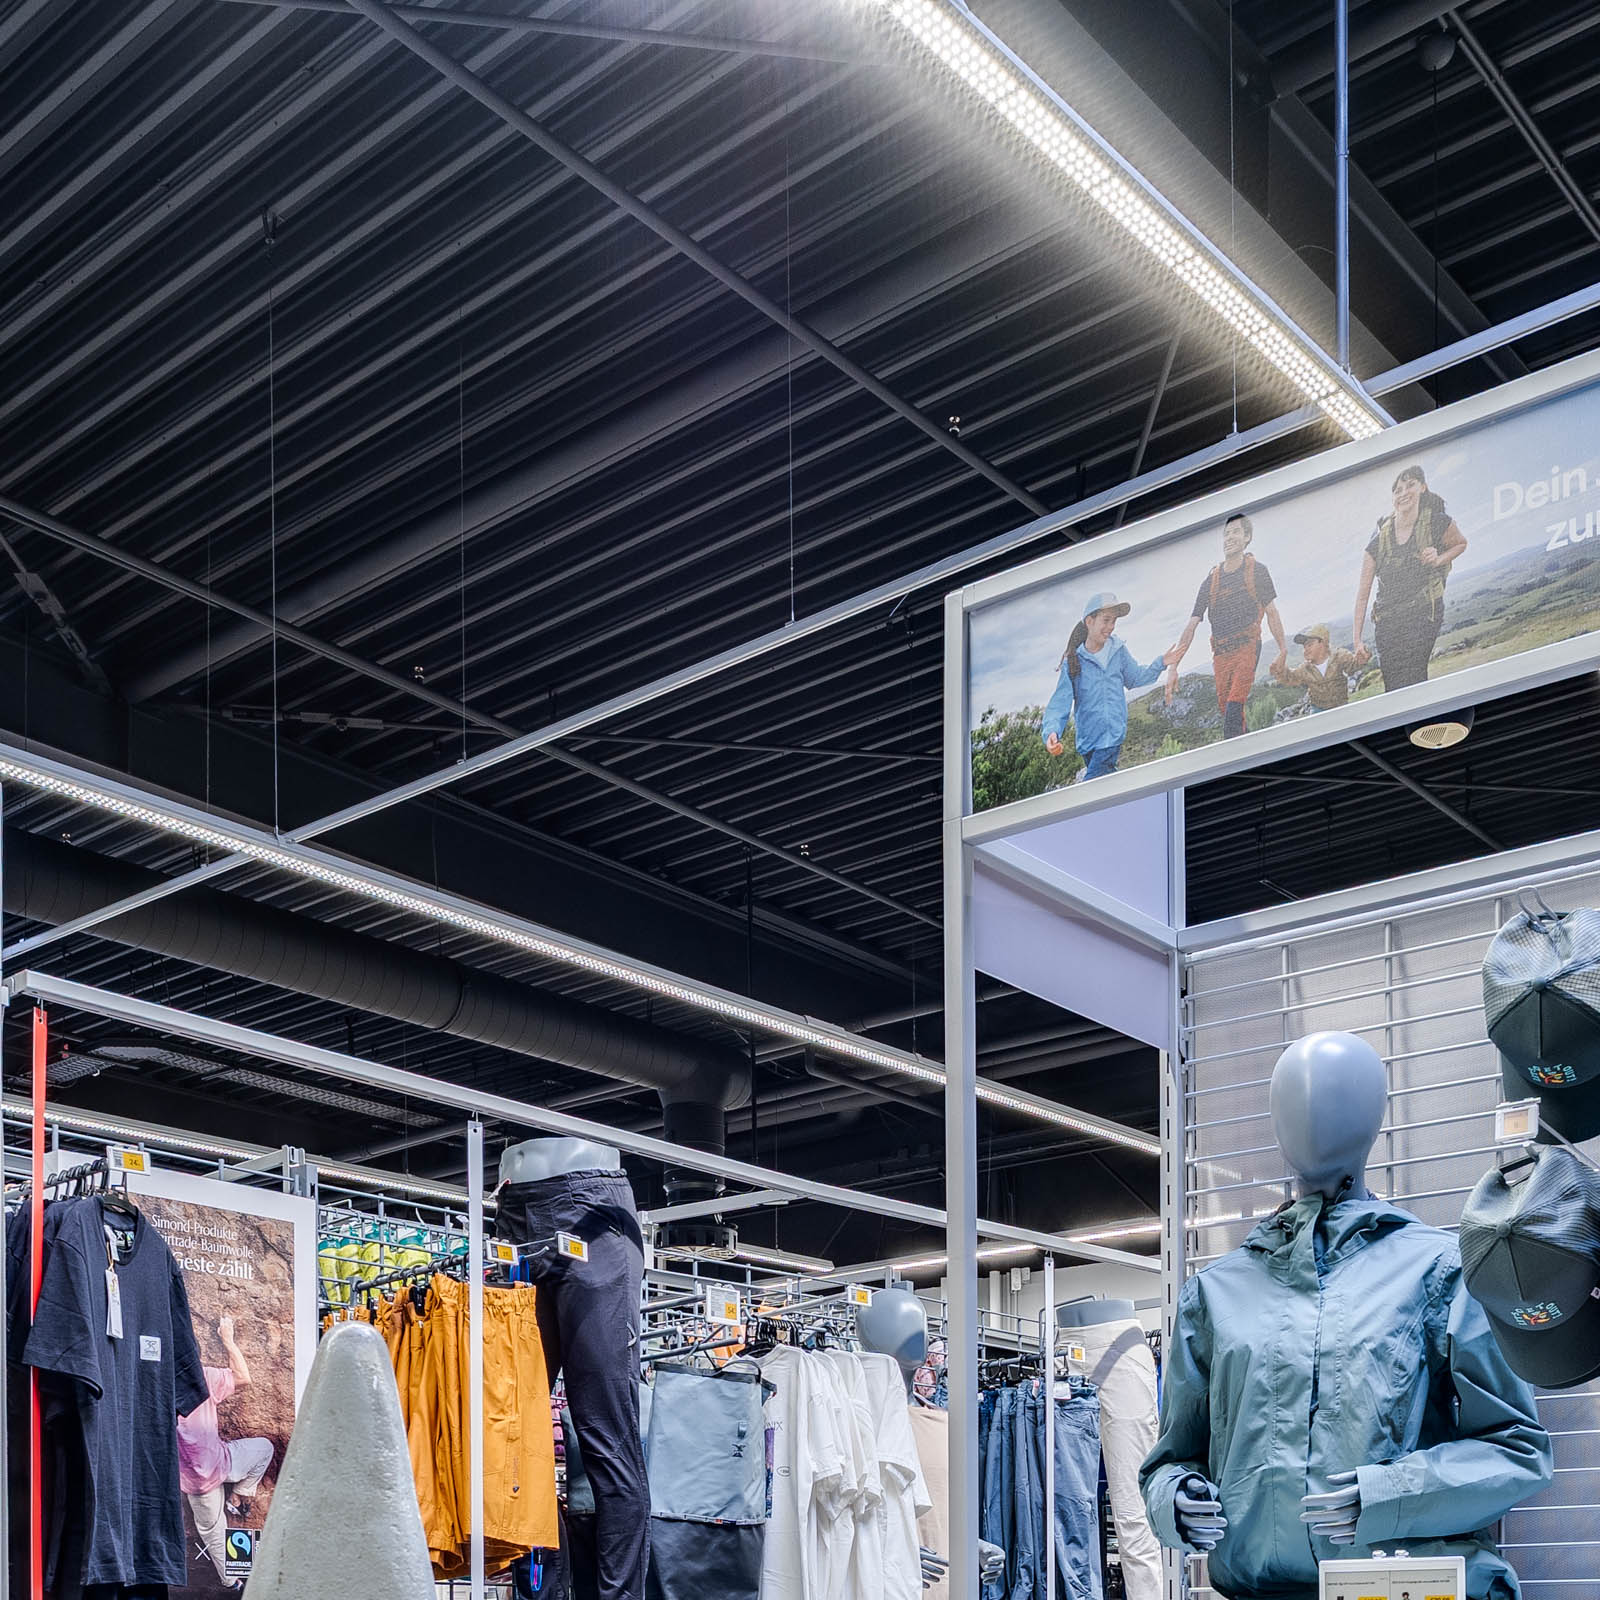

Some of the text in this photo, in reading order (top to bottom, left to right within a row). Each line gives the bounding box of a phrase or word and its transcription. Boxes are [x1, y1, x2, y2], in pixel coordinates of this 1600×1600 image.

[1492, 464, 1588, 521] Dein
[151, 1214, 238, 1241] Simond-Produkte
[160, 1231, 254, 1259] irtrade-Baumwolle
[218, 1260, 255, 1281] zählt
